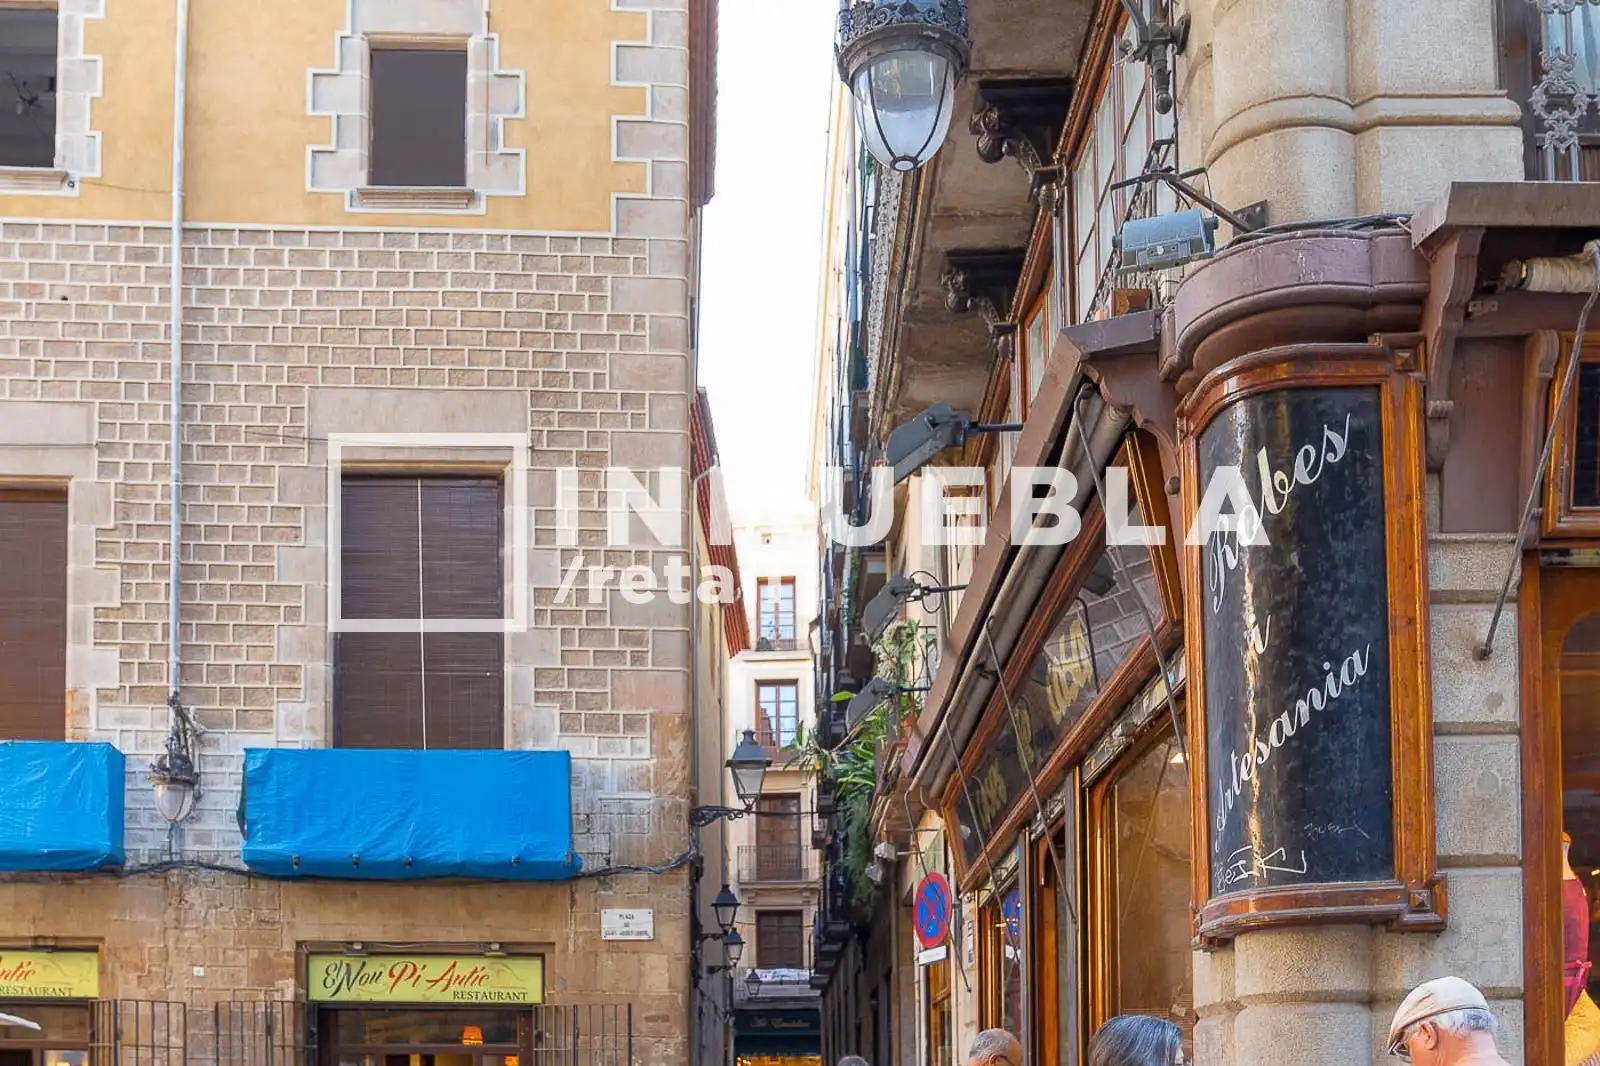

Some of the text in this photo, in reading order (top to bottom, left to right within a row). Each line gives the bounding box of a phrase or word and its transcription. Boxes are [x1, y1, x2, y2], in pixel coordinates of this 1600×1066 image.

[1209, 412, 1351, 614] Robes
[1214, 643, 1370, 853] Artesania
[0, 984, 73, 996] RESTAURANT
[329, 960, 384, 998] Nou
[388, 960, 427, 994] Pi
[453, 990, 528, 1001] RESTAURANT
